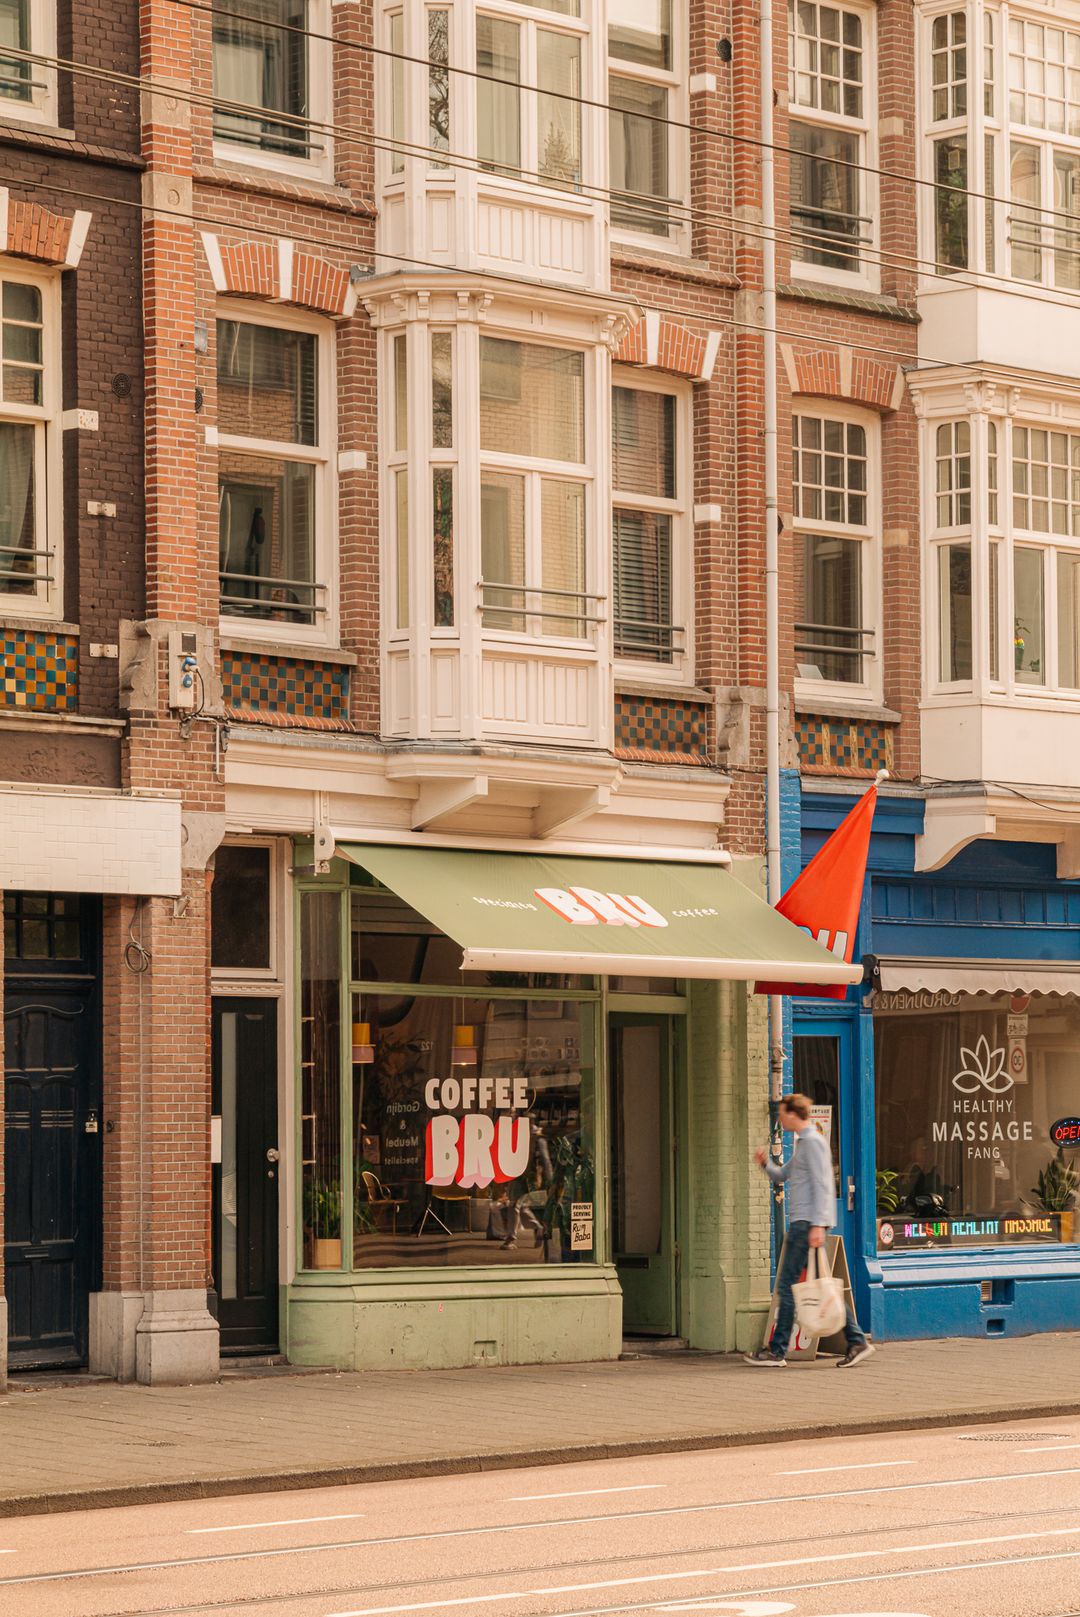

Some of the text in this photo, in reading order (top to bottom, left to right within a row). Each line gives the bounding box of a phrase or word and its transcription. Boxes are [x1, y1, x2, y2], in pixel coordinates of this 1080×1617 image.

[472, 886, 719, 928] specialty BRU coffee
[425, 1078, 529, 1110] COFFEE
[953, 1100, 1013, 1113] HEALTHY
[932, 1121, 1033, 1142] MASSAGE
[424, 1114, 530, 1189] BRU
[967, 1147, 1000, 1159] FANG
